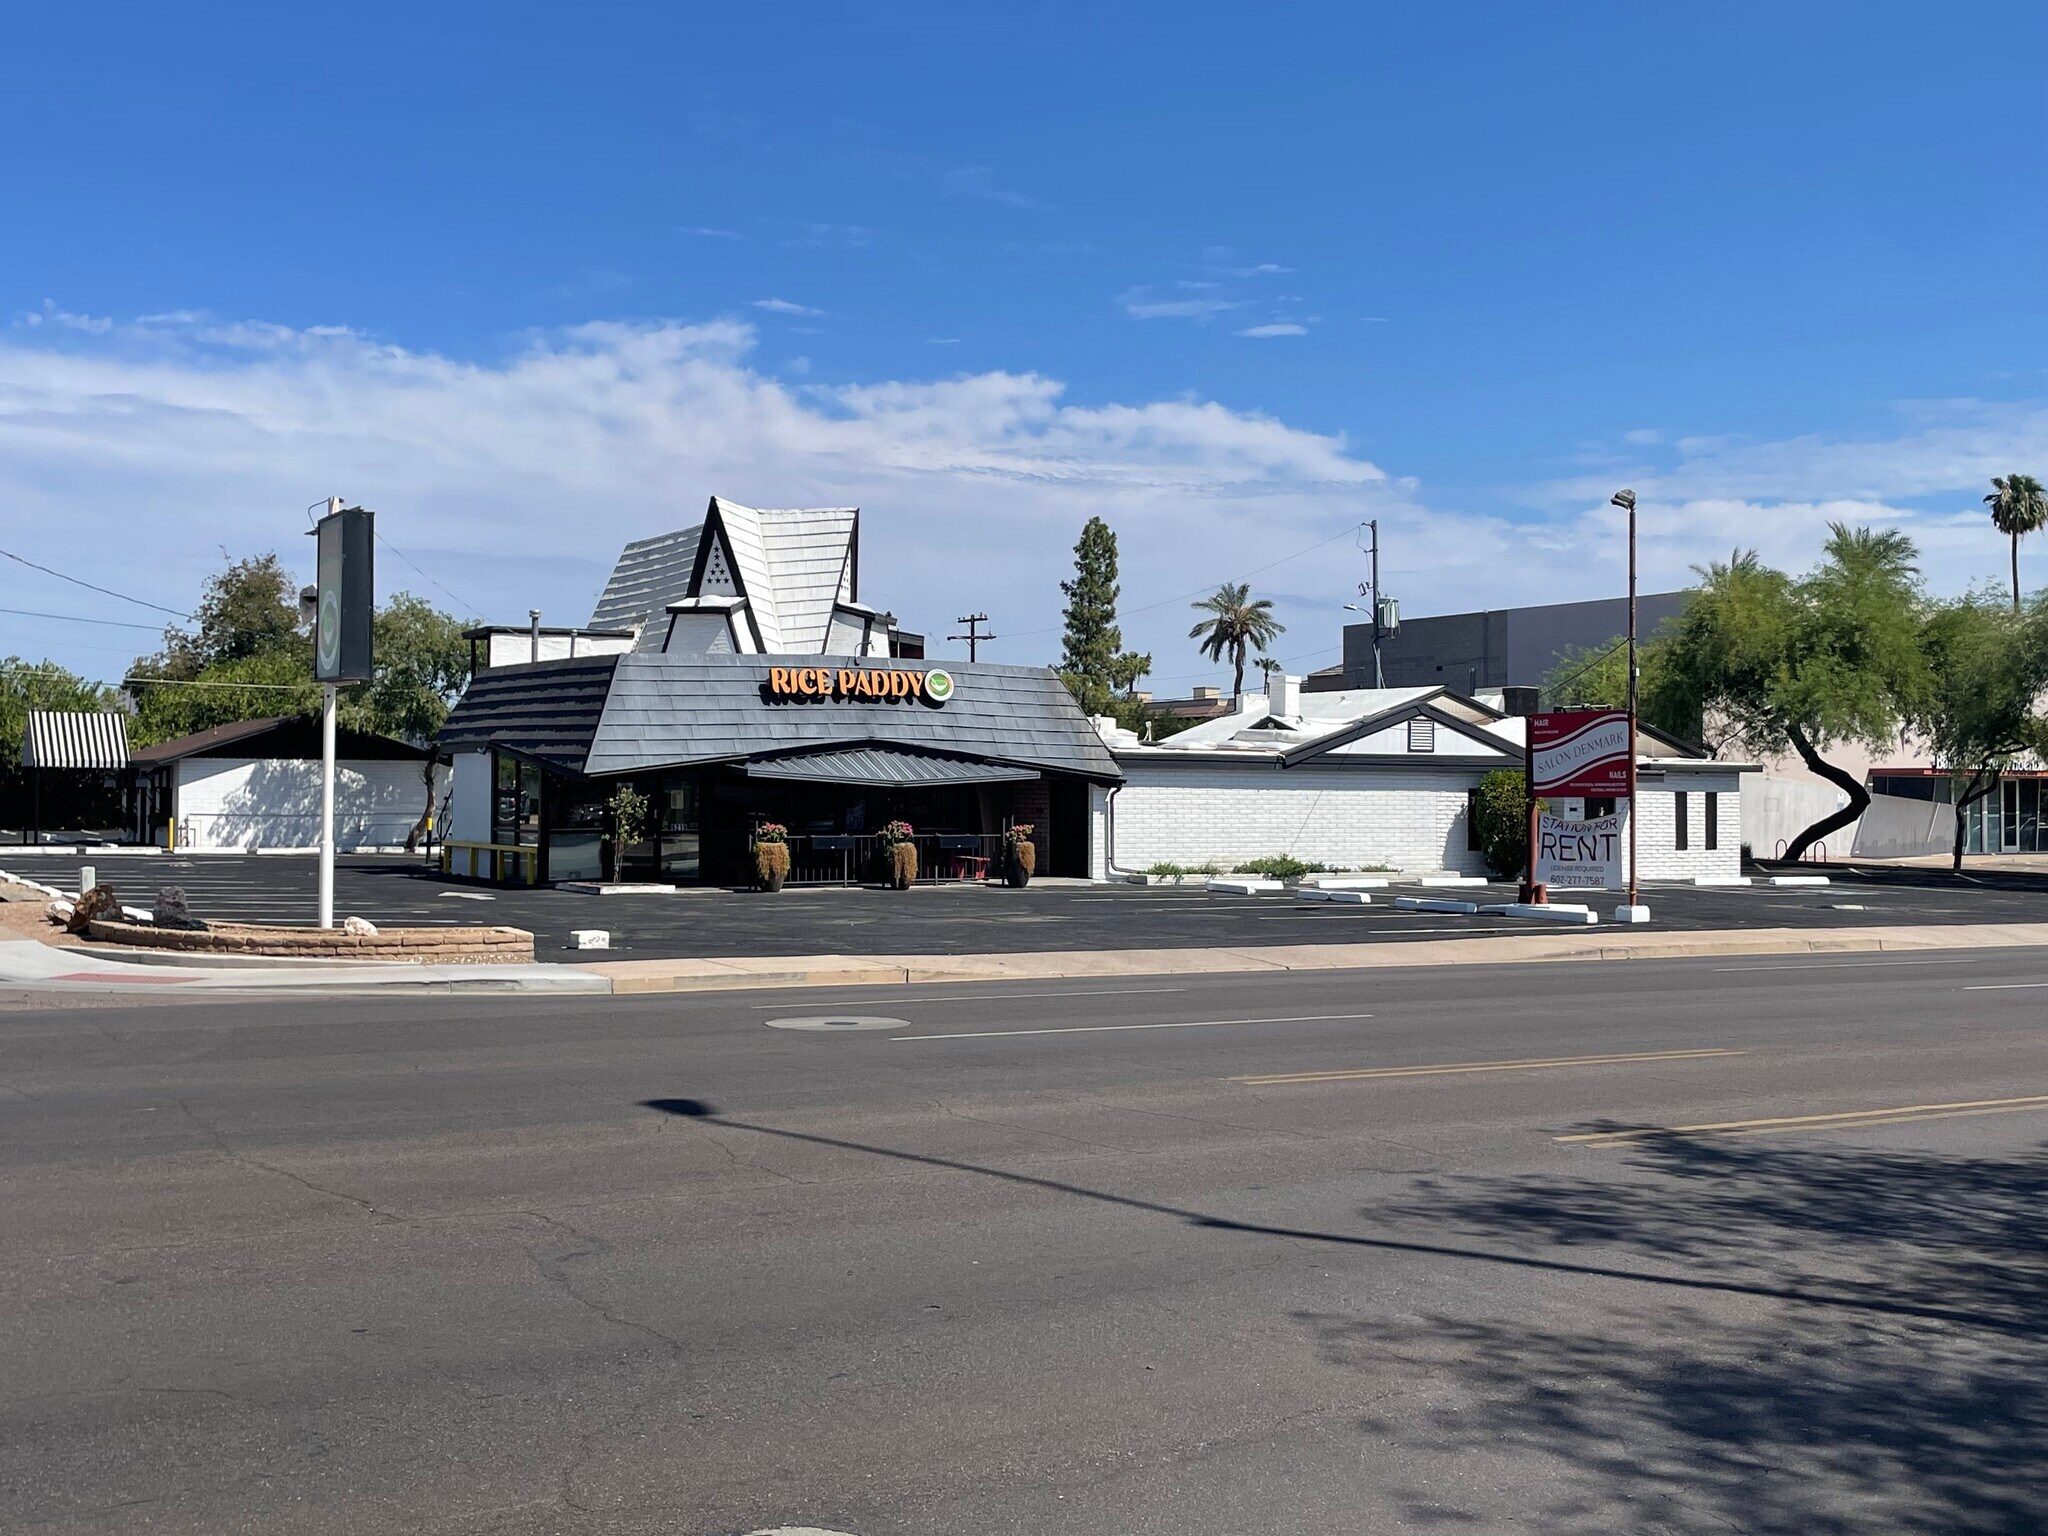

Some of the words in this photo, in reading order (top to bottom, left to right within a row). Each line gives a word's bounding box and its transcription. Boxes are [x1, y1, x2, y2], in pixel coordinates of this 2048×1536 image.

[769, 667, 833, 695] RICE
[838, 669, 923, 697] PADDY
[1534, 718, 1549, 727] HAIR
[1538, 751, 1571, 774] SALON
[1573, 731, 1624, 758] DENMARK
[1609, 771, 1627, 779] NAILS
[1543, 816, 1592, 833] STATION
[1593, 817, 1618, 832] FOR
[1540, 832, 1618, 862] RENT
[1575, 865, 1605, 873] REQUIRED
[1550, 875, 1605, 886] 602-277-7587
